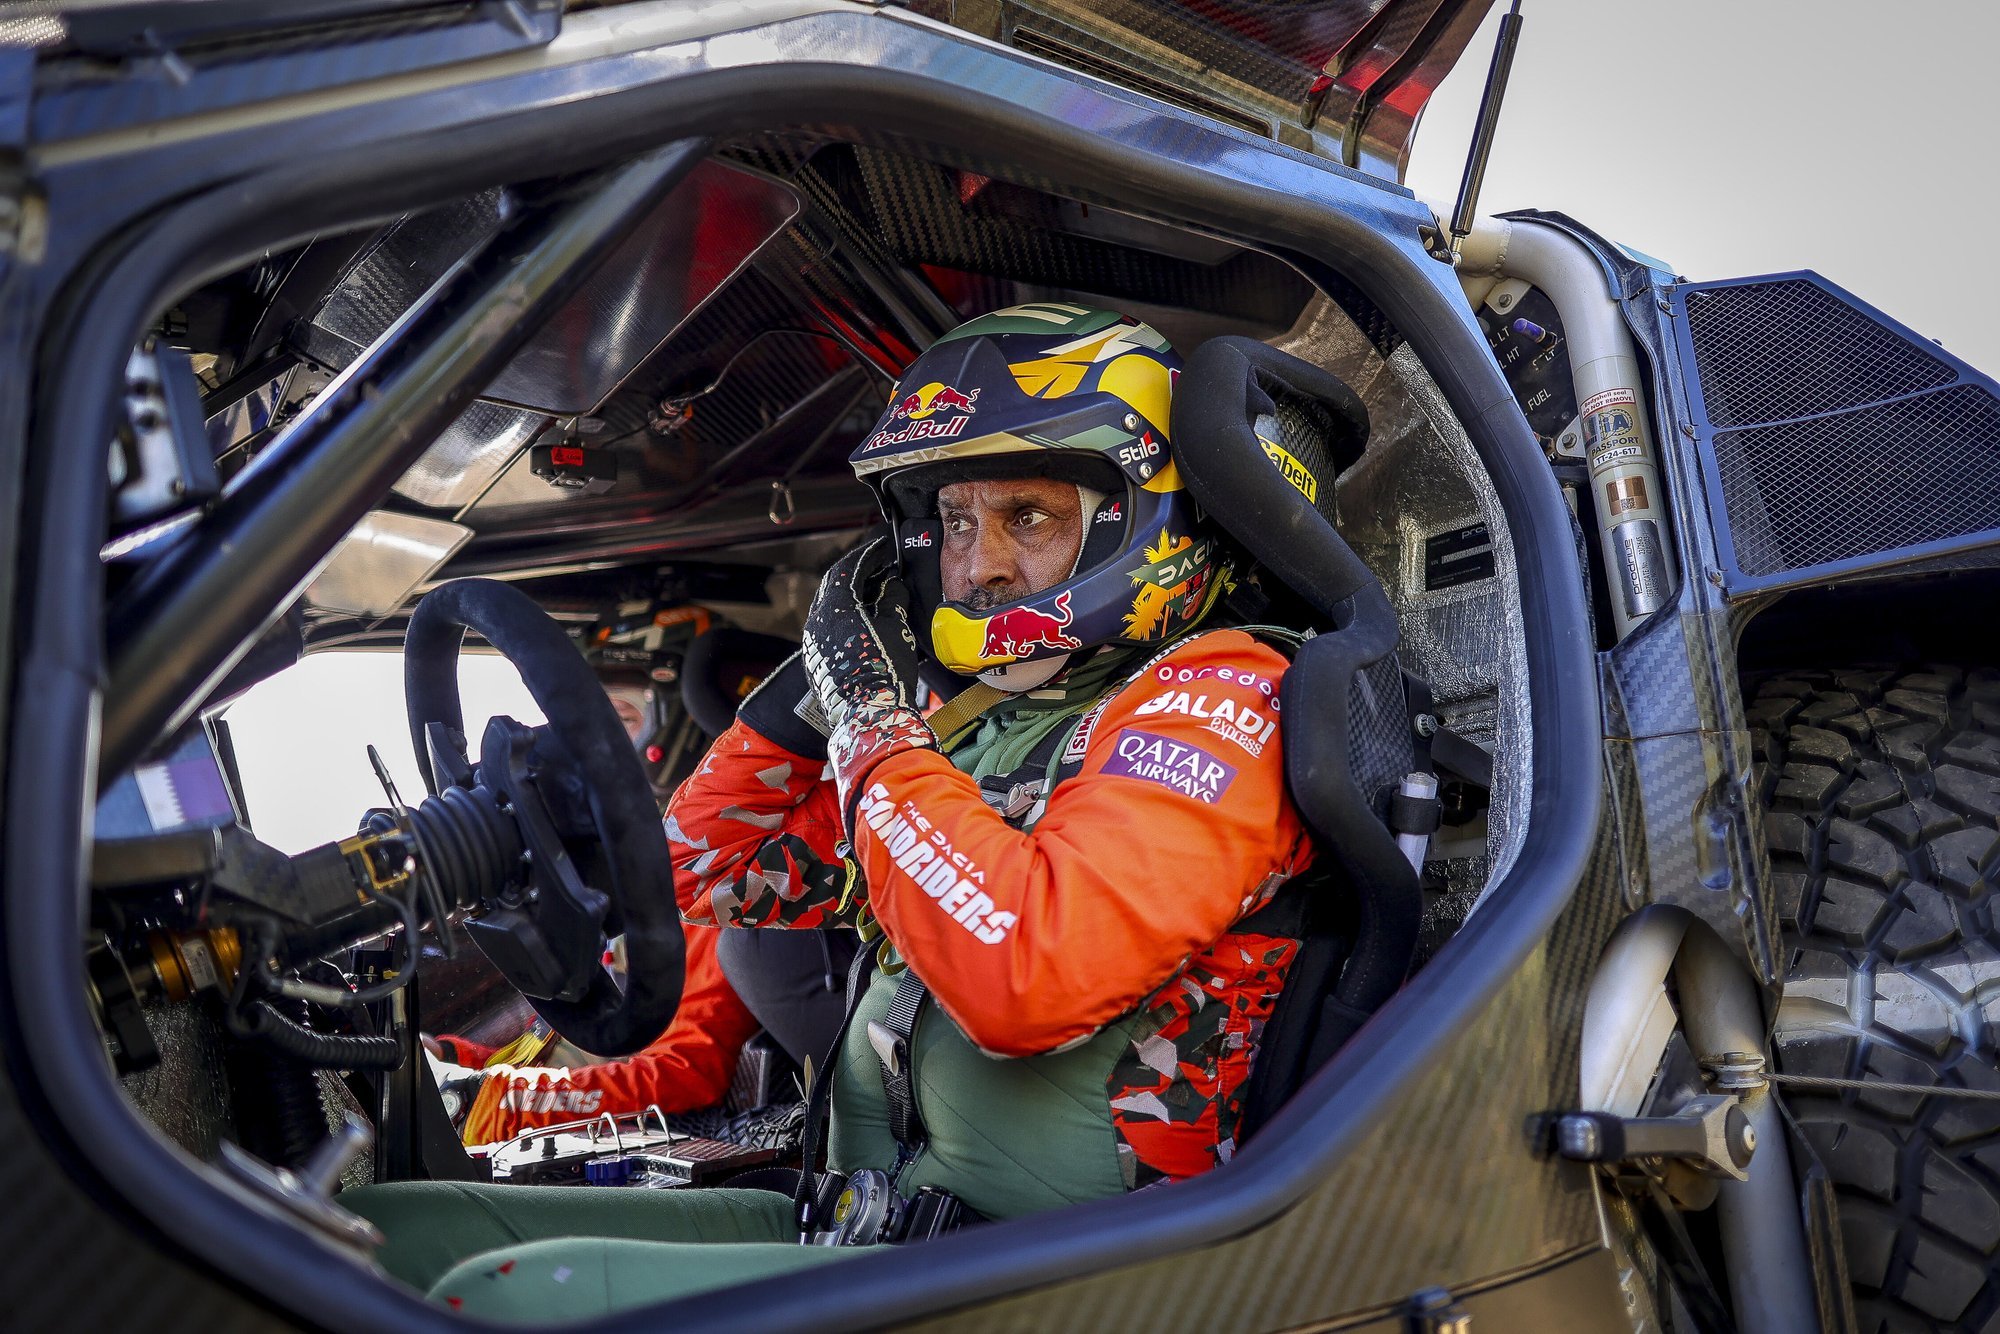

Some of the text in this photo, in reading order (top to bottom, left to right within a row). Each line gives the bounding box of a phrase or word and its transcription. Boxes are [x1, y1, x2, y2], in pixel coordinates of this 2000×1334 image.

[1497, 325, 1511, 342] LT
[1507, 345, 1521, 364] HT
[1527, 388, 1552, 411] FUEL
[1590, 401, 1604, 410] NOT
[1605, 396, 1633, 404] REMOVE
[1118, 434, 1160, 465] Stilo
[1591, 436, 1639, 456] PASSPORT
[1596, 448, 1637, 465] TT-24-617
[1096, 504, 1122, 523] Stilo
[904, 532, 931, 549] Stilo
[1624, 539, 1642, 595] prodrive
[1157, 666, 1281, 712] ooredoo
[1134, 690, 1277, 745] BALADI
[1210, 716, 1263, 756] express
[1118, 735, 1226, 792] QATAR
[1127, 759, 1215, 803] AIRWAYS
[902, 800, 985, 885] THE DACIA
[858, 782, 1018, 945] SANDRIDERS
